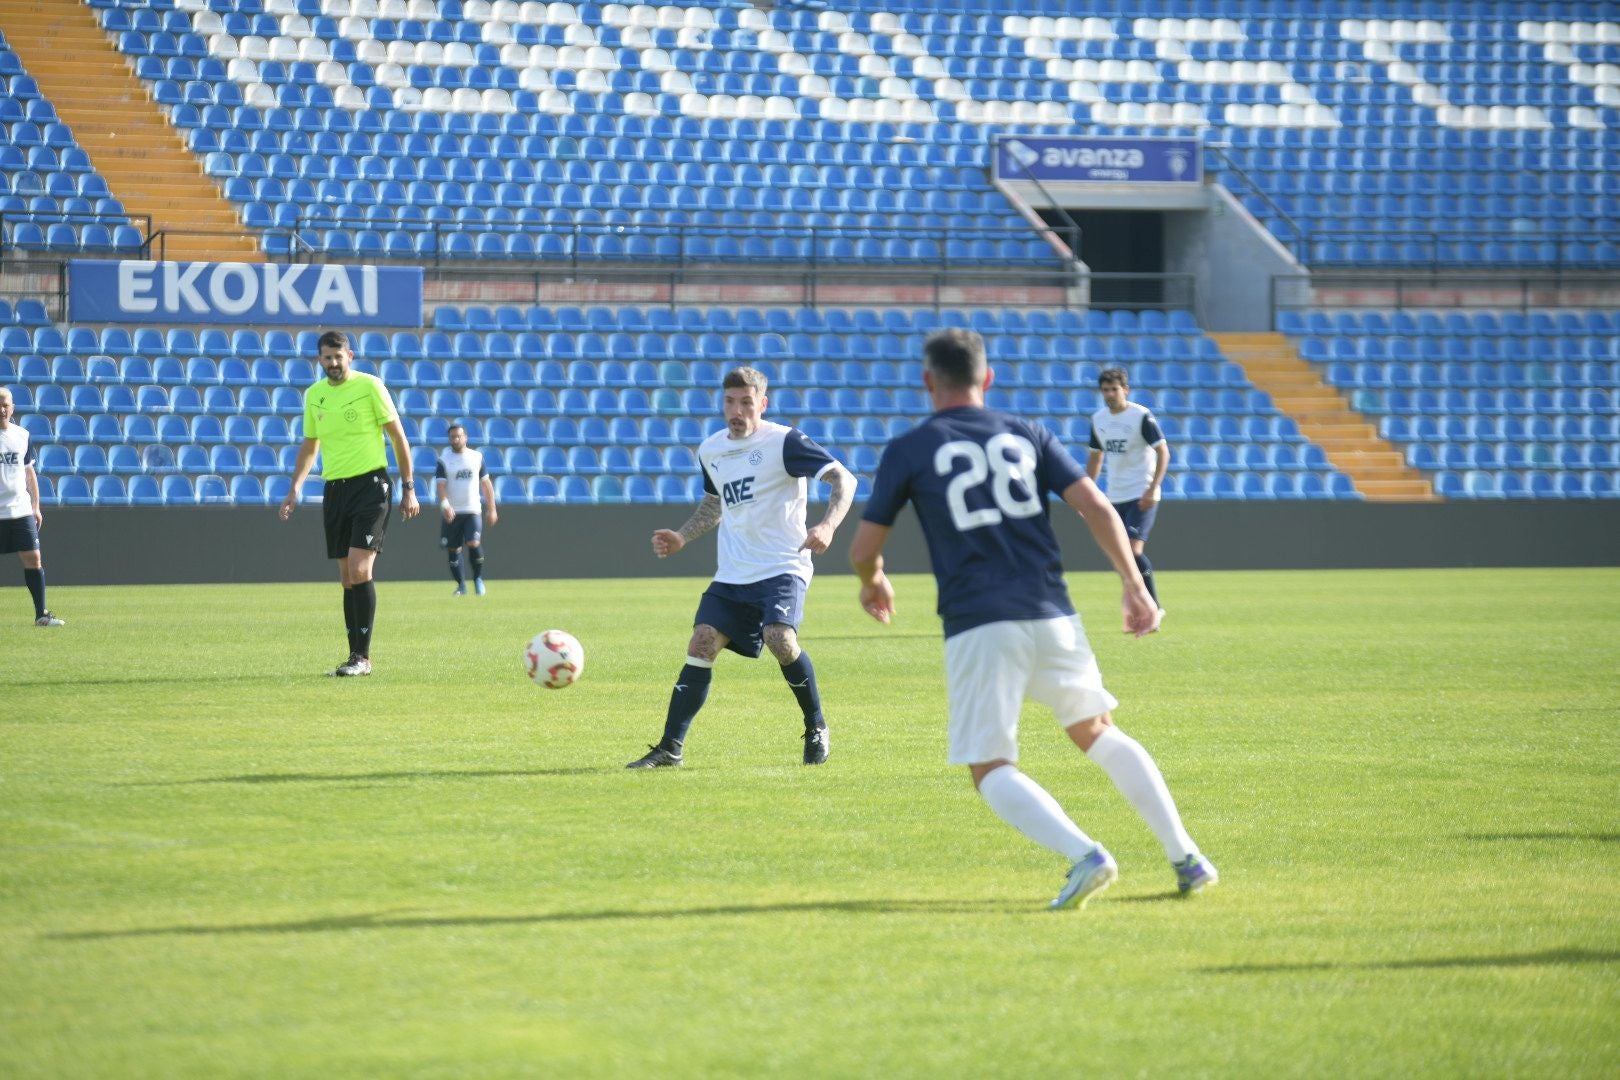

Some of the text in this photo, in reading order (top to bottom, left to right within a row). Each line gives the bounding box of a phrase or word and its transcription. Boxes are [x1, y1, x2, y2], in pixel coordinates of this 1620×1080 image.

[1042, 147, 1145, 168] avanza
[118, 260, 378, 316] EKOKAI
[1105, 439, 1128, 453] AFE
[723, 476, 755, 506] AFE
[934, 433, 1042, 532] 28
